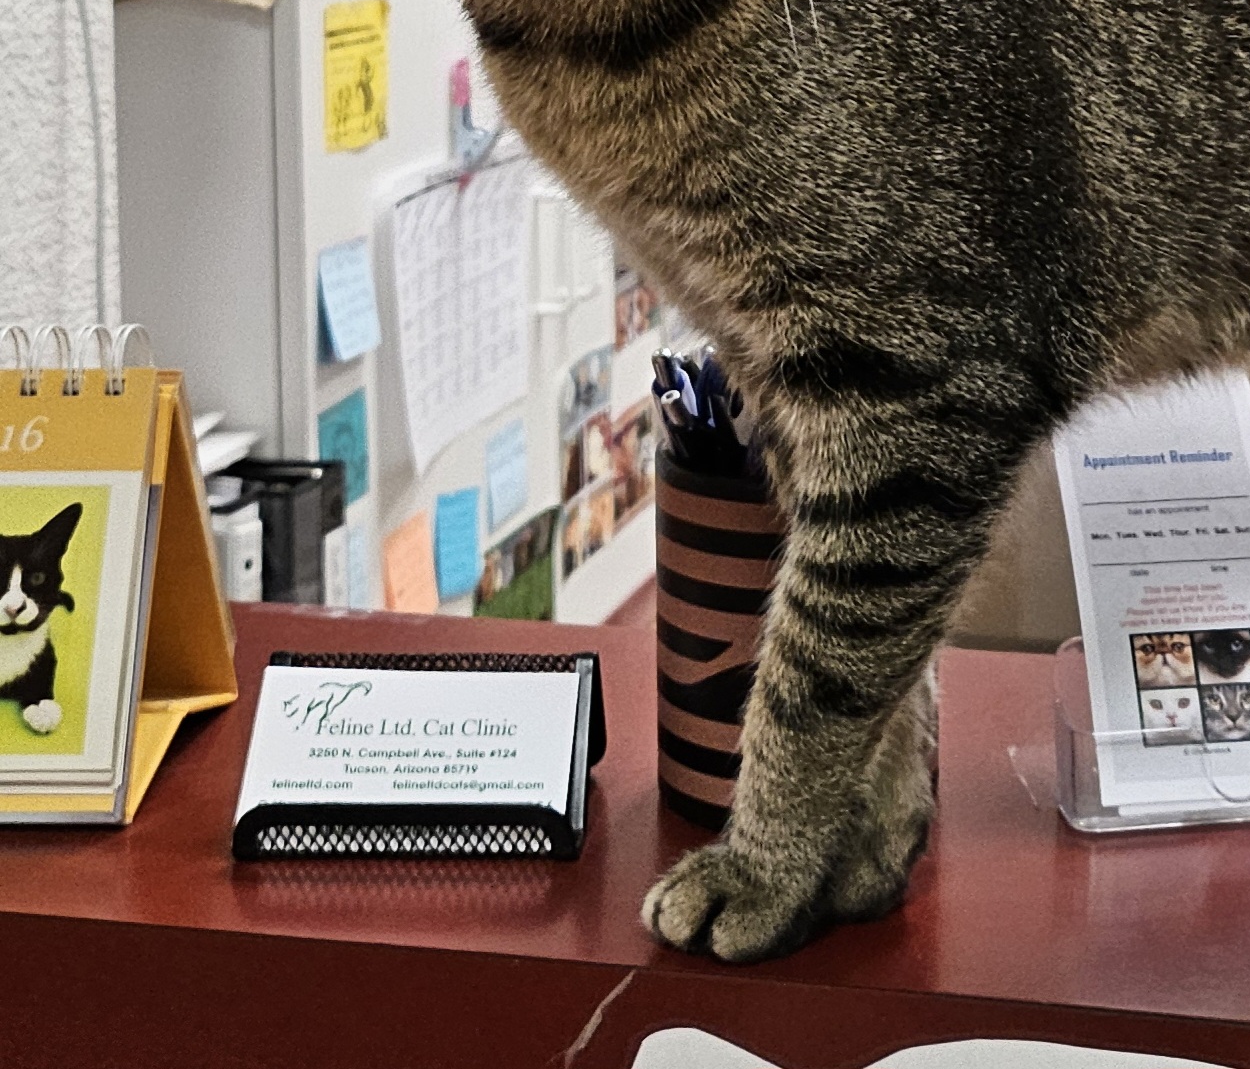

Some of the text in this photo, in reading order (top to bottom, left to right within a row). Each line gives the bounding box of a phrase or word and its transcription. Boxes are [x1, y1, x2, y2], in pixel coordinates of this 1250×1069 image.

[1083, 448, 1233, 470] Appointment Reminder
[315, 717, 517, 736] Feline Ltd. Cat Clinic
[342, 748, 354, 758] N.
[359, 747, 420, 760] Campbell
[456, 748, 486, 758] Suite
[489, 749, 517, 759] #124
[393, 764, 440, 774] Arizona
[443, 764, 478, 774] 85719
[272, 779, 353, 789] felineltd.com
[393, 779, 544, 792] felineltdcats@gmail.com
